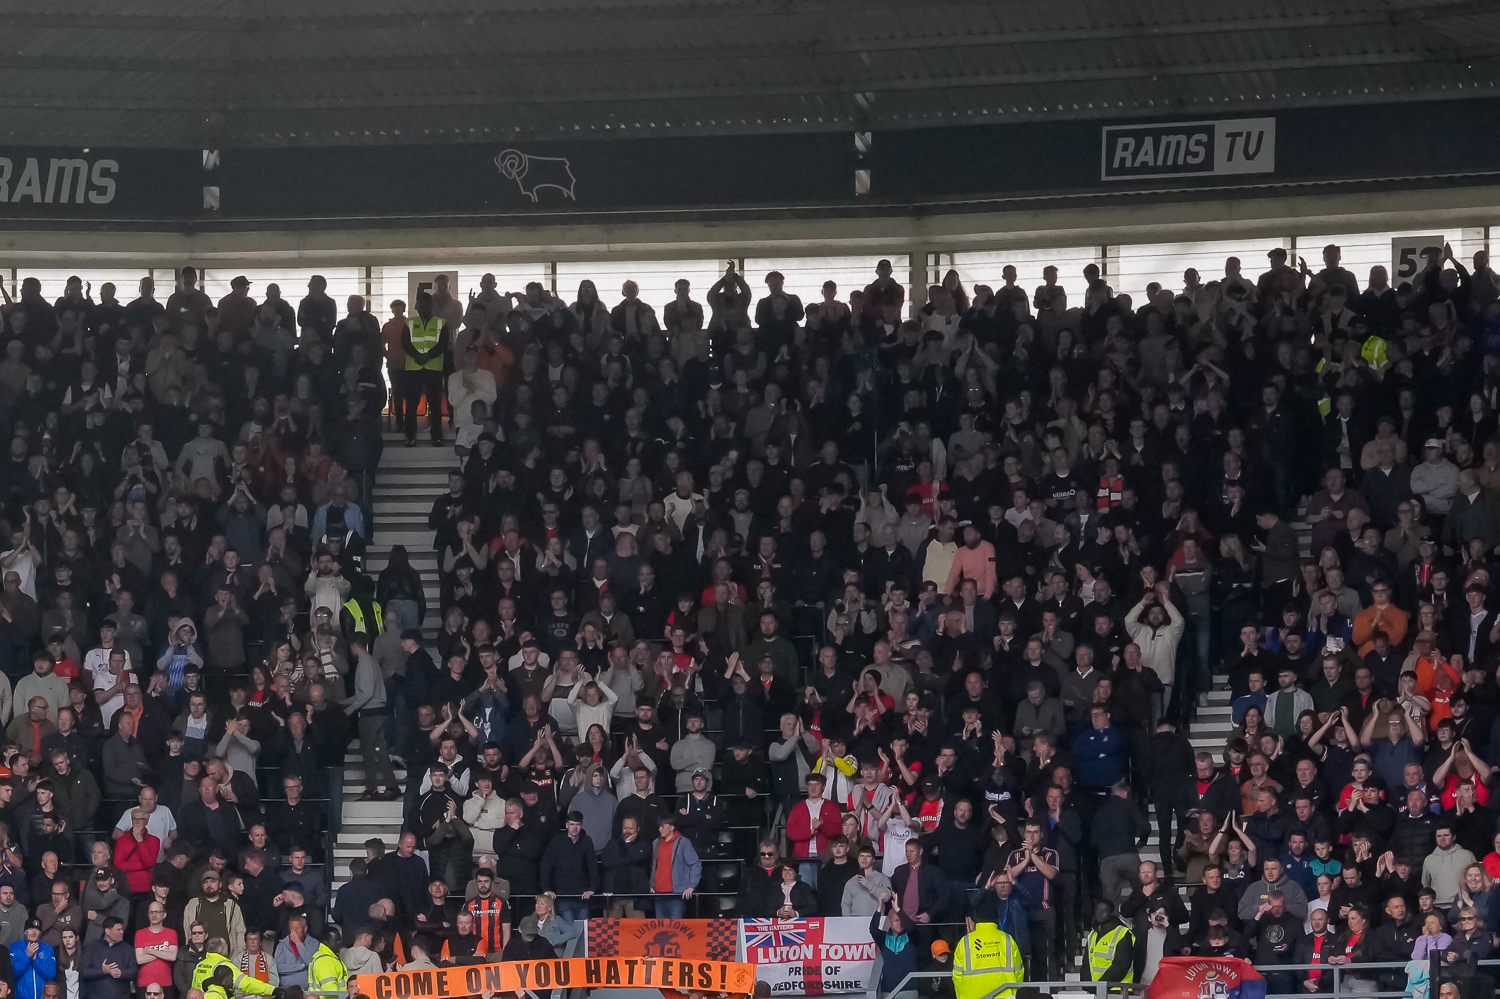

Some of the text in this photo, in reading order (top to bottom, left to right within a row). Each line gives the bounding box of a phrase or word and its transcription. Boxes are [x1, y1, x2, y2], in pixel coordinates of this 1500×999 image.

[1112, 129, 1265, 169] RAMS TV
[633, 918, 696, 941] LUTON TOWN
[757, 942, 876, 964] LUTON TOWN
[975, 951, 1001, 959] Steward
[465, 965, 501, 994] ON
[515, 961, 571, 989] YOU
[585, 959, 728, 990] HATTERS!
[788, 966, 841, 976] PRIDE OF
[1184, 962, 1238, 982] LUTON TOWN
[772, 980, 862, 992] BEDFORDSHIRE
